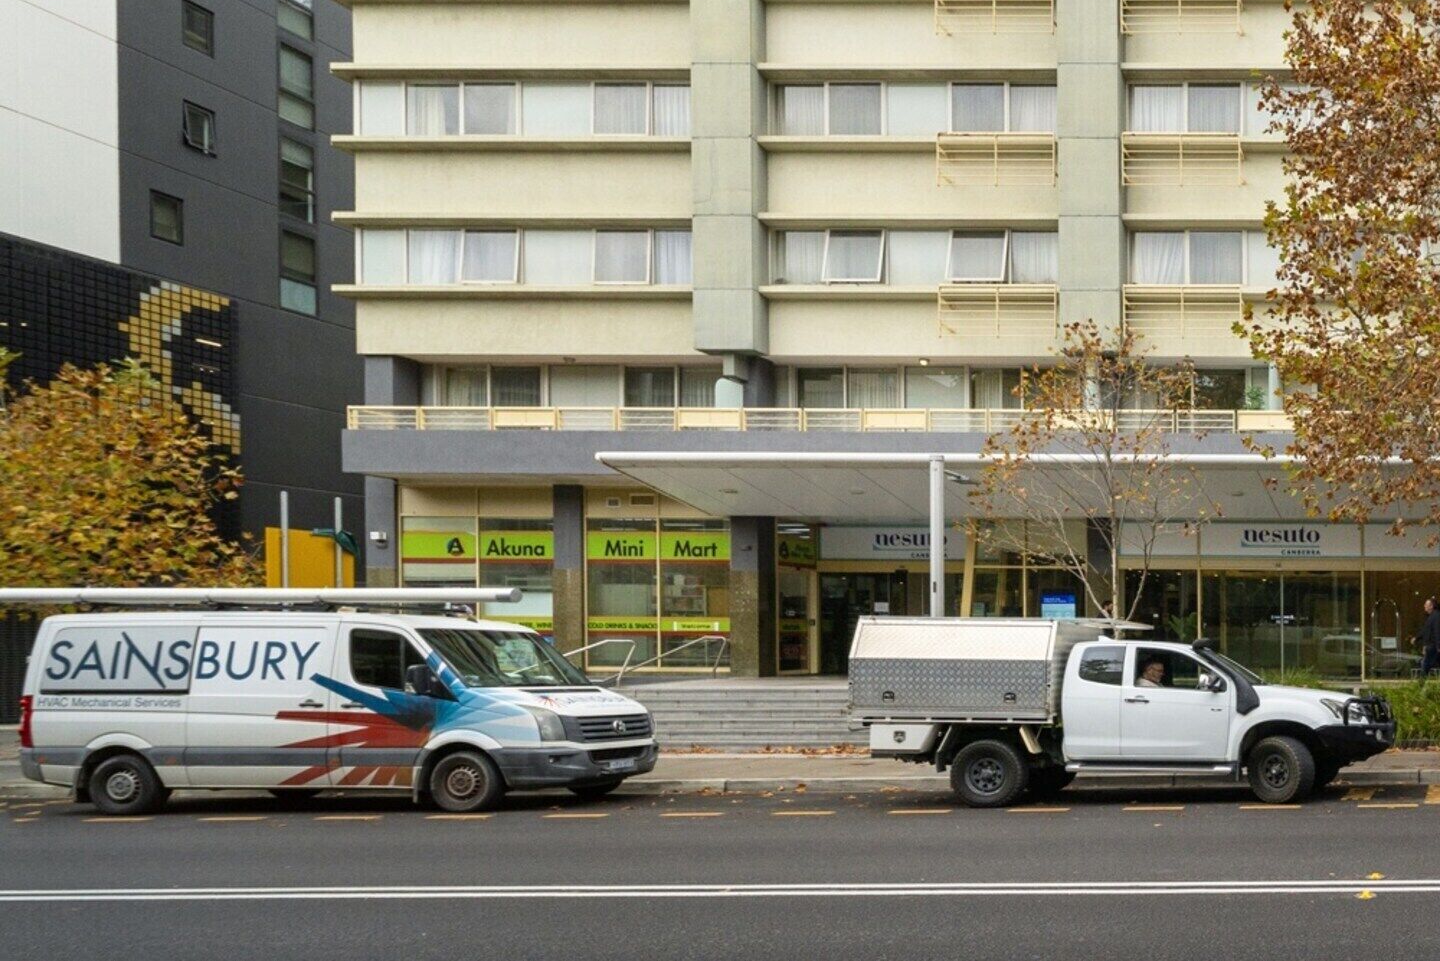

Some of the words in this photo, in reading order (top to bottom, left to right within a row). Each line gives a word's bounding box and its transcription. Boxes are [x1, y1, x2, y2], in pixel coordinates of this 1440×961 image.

[1243, 526, 1320, 543] nesuto
[486, 538, 545, 557] Akuna
[604, 539, 644, 557] Mini
[673, 539, 718, 558] Mart
[45, 631, 320, 689] SAINSBURY
[37, 697, 68, 708] HVAC
[72, 697, 131, 708] Mechanical
[135, 697, 181, 708] Services
